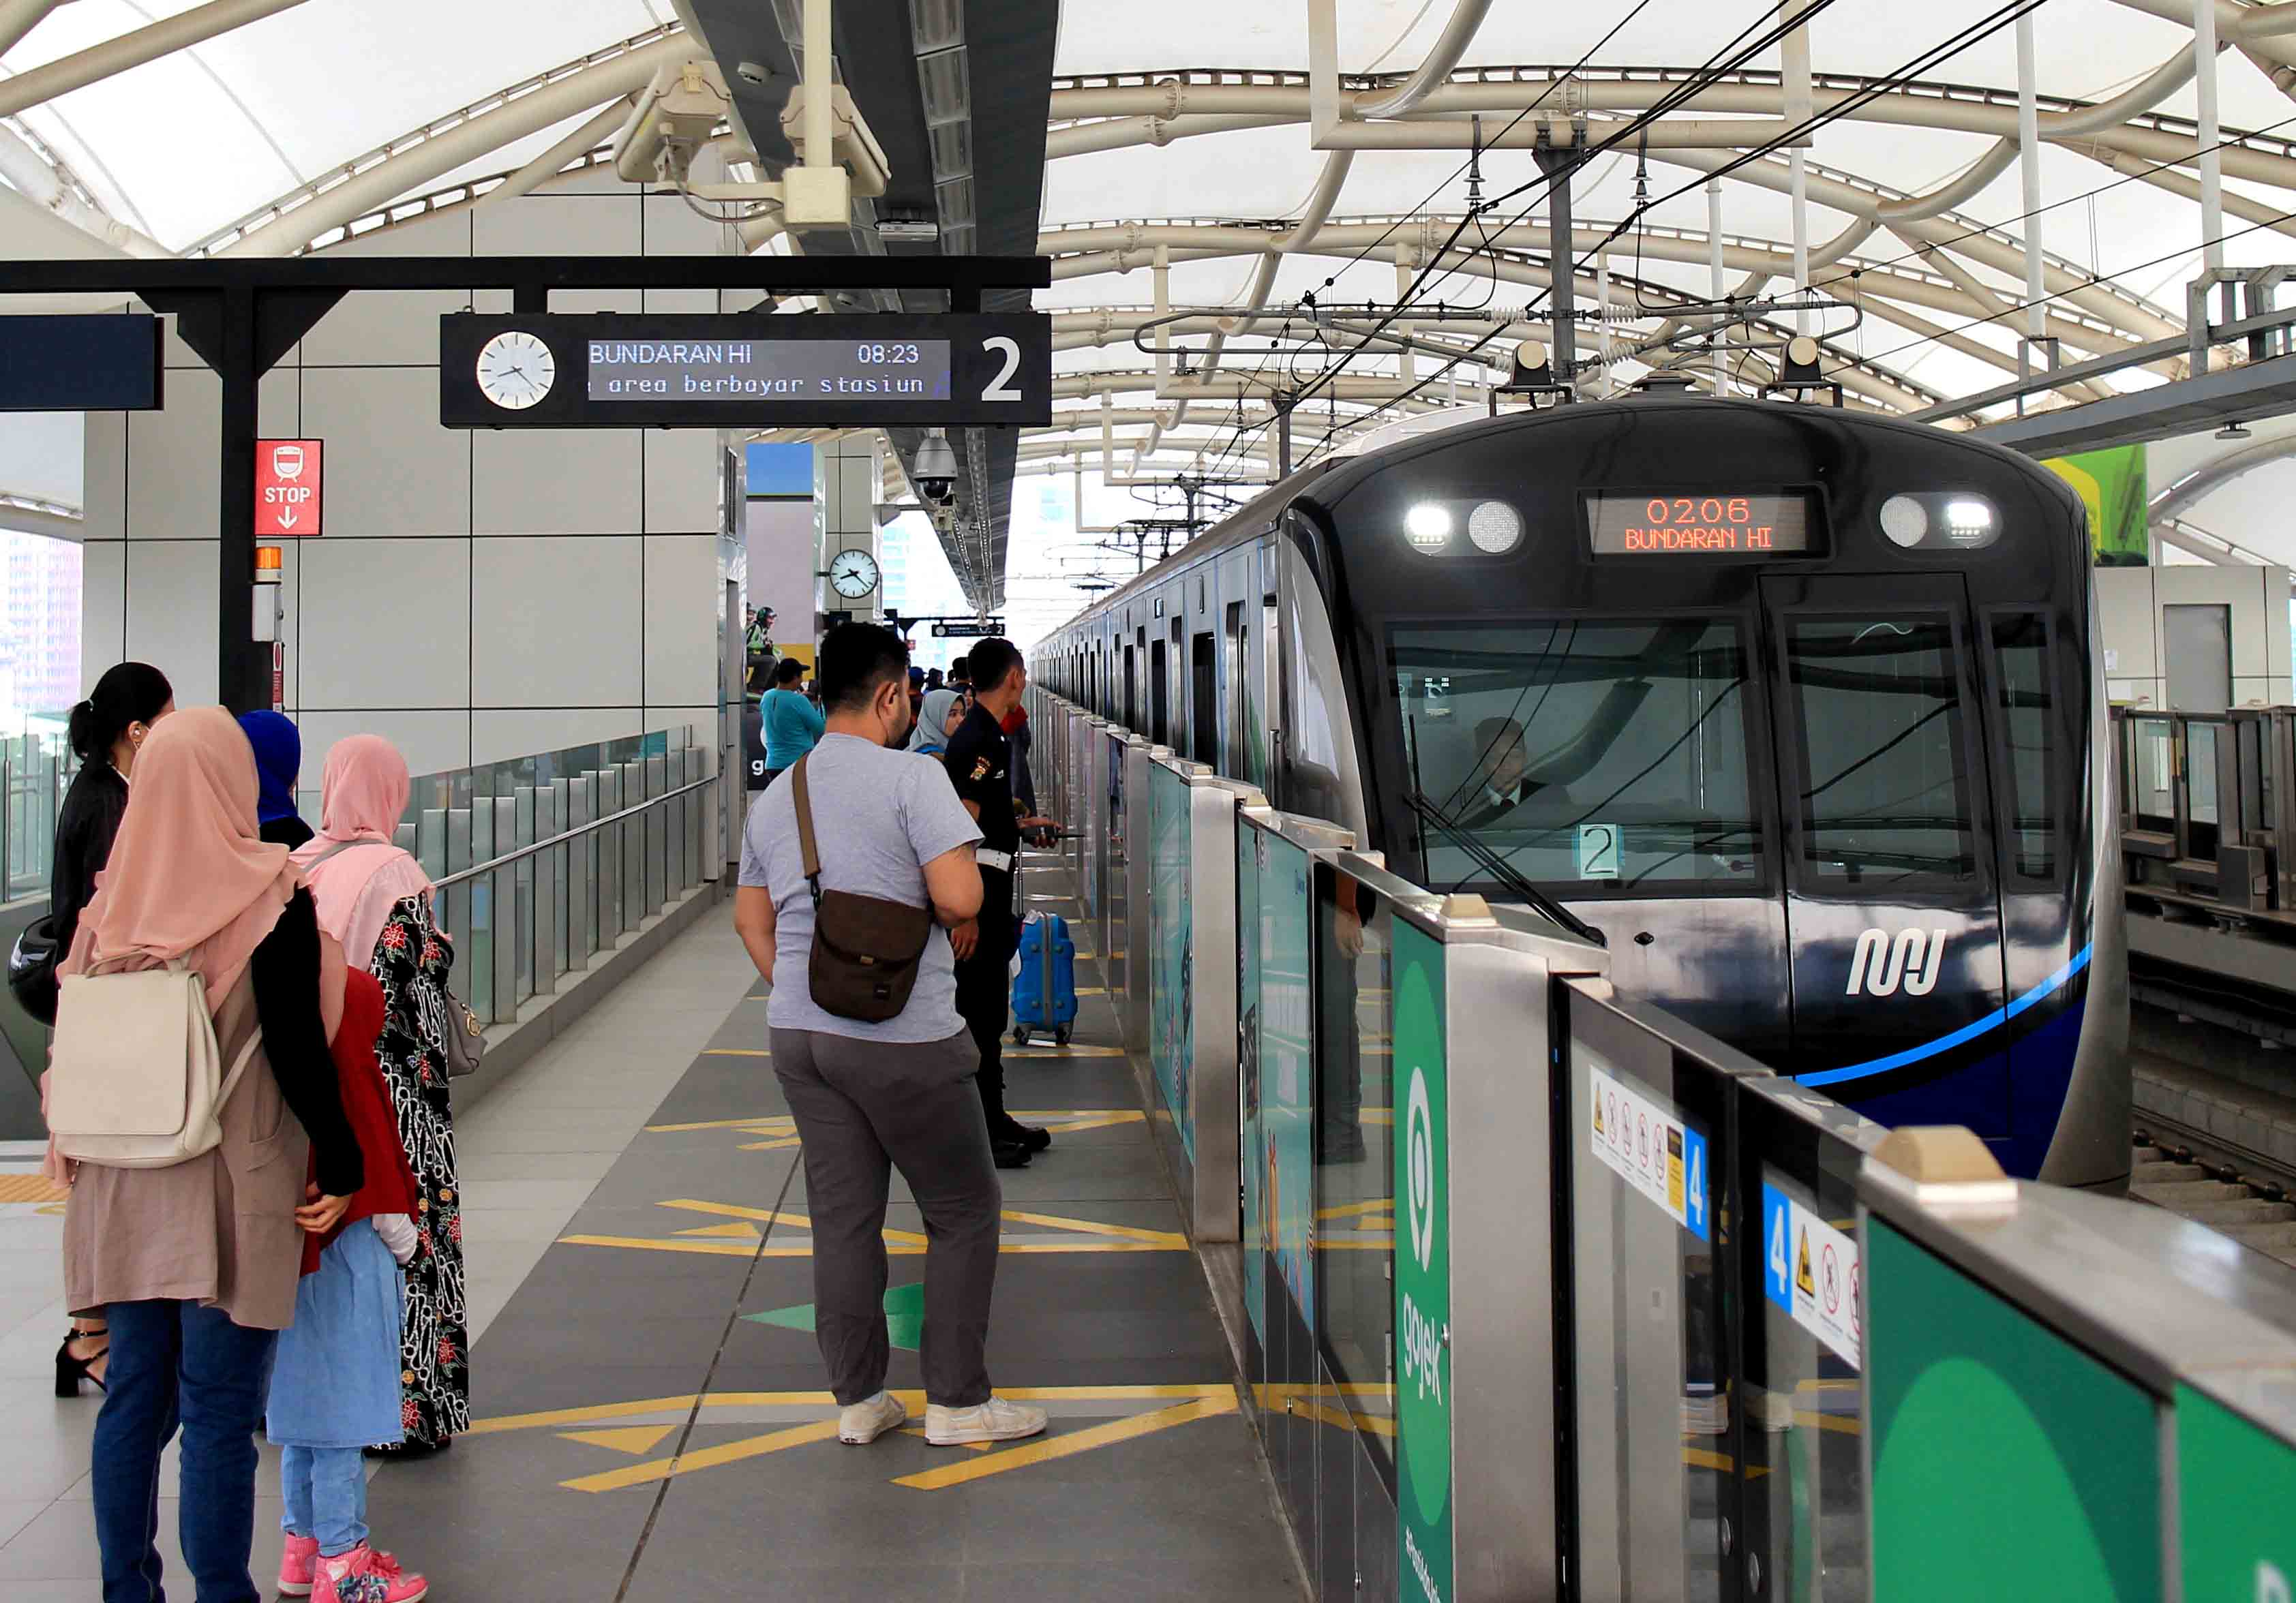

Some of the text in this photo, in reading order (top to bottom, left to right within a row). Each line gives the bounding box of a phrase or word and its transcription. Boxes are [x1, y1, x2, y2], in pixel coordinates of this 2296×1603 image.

[590, 344, 919, 364] BUNDARAN HI 08:23
[981, 336, 1022, 401] 2
[609, 379, 667, 393] area
[684, 375, 804, 396] berbayar
[820, 375, 923, 393] stasiun
[265, 487, 311, 503] STOP
[1646, 498, 1751, 523] 0206
[1625, 527, 1772, 550] BUNDARAN HI
[1584, 828, 1612, 873] 2
[1690, 1145, 1704, 1225] 4
[1771, 1204, 1788, 1295] 4
[1404, 1292, 1442, 1406] gojek
